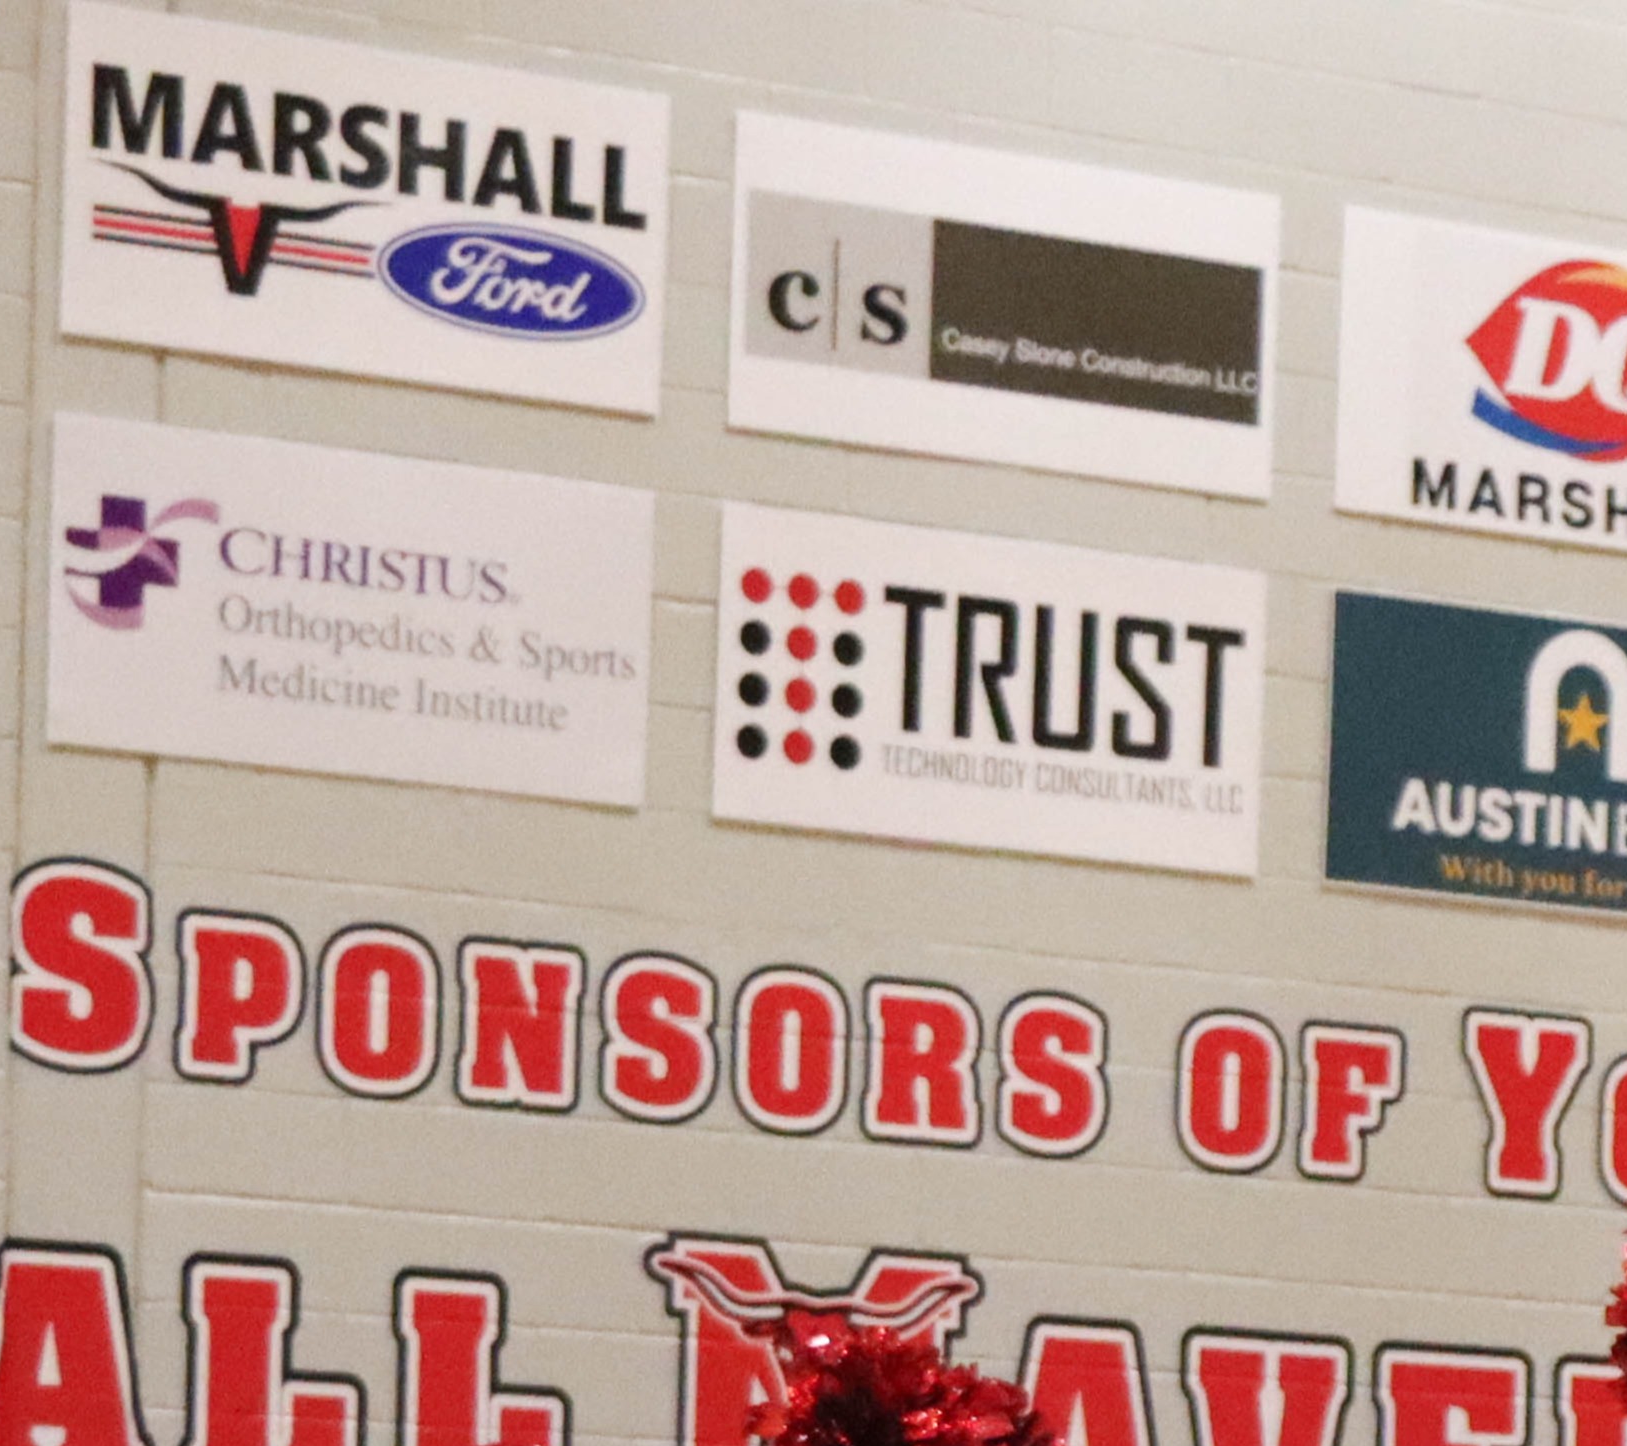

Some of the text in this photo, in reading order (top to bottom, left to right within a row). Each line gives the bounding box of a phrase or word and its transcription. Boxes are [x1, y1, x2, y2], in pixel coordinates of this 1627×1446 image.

[90, 62, 647, 231] MARSHALL
[430, 236, 589, 323] Ford
[1081, 348, 1211, 386] Construction
[1214, 368, 1257, 396] LLC
[219, 595, 637, 682] Orthopedics & Sports
[884, 586, 1246, 767] TRUST
[219, 654, 570, 731] Medicine Institute
[882, 744, 1027, 790] TECHNOLOGY
[1204, 782, 1245, 815] LLC
[1440, 854, 1514, 887] With
[1523, 868, 1575, 895] you
[10, 857, 1107, 1158] SPONSORS
[1176, 1010, 1402, 1182] OF
